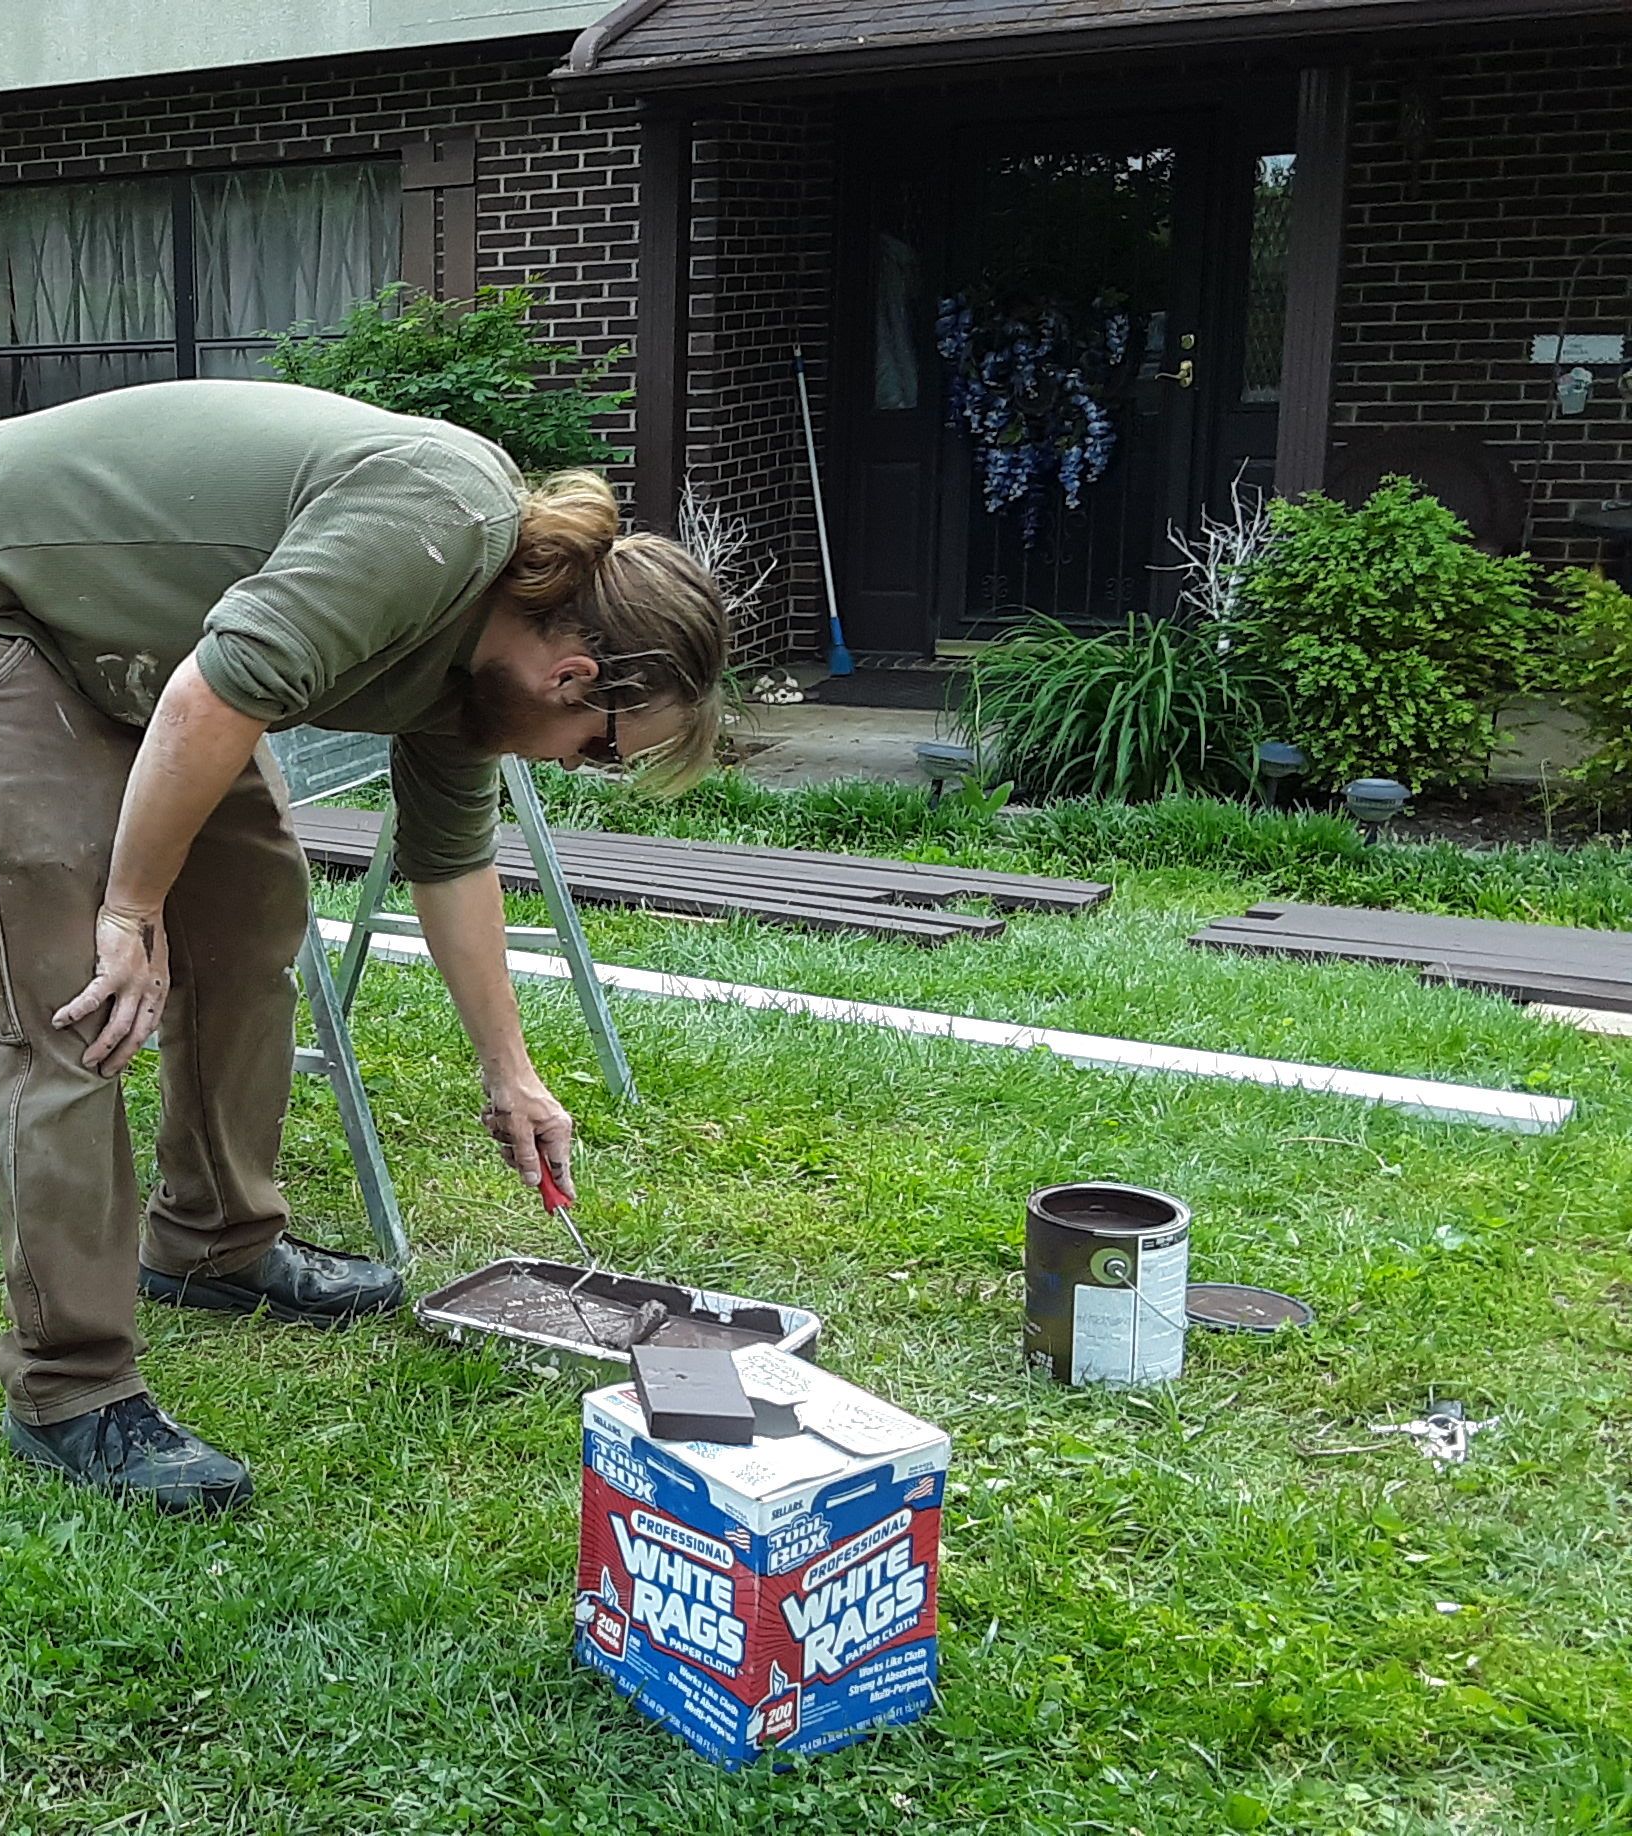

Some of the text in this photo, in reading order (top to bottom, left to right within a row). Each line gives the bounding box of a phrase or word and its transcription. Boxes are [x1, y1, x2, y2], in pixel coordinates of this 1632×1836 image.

[593, 1436, 645, 1478] TOOL
[596, 1454, 654, 1503] BOX
[770, 1516, 824, 1548] TOOL
[771, 1499, 804, 1521] SELLARS
[637, 1513, 730, 1565] PROFESSIONAL
[769, 1527, 829, 1572] BOX
[808, 1514, 907, 1586] PROFESSIONAL
[609, 1513, 733, 1613] WHITE
[781, 1537, 910, 1639] WHITE
[596, 1612, 621, 1638] 200
[632, 1577, 745, 1662] RAGS
[803, 1565, 925, 1679] RAGS
[845, 1614, 918, 1665] PAPER CLOTH
[669, 1637, 736, 1678] PAPER CLOTH
[848, 1661, 927, 1697] Strong & Absorbent
[859, 1662, 883, 1678] Works
[885, 1656, 903, 1668] Like
[668, 1672, 692, 1698] Strong
[692, 1691, 700, 1702] &
[700, 1696, 737, 1731] Absorbent
[679, 1665, 702, 1689] Works
[703, 1683, 718, 1701] Like
[869, 1678, 927, 1703] Multi-Purpose
[684, 1699, 736, 1744] Multi-Purpose
[767, 1701, 793, 1726] 200
